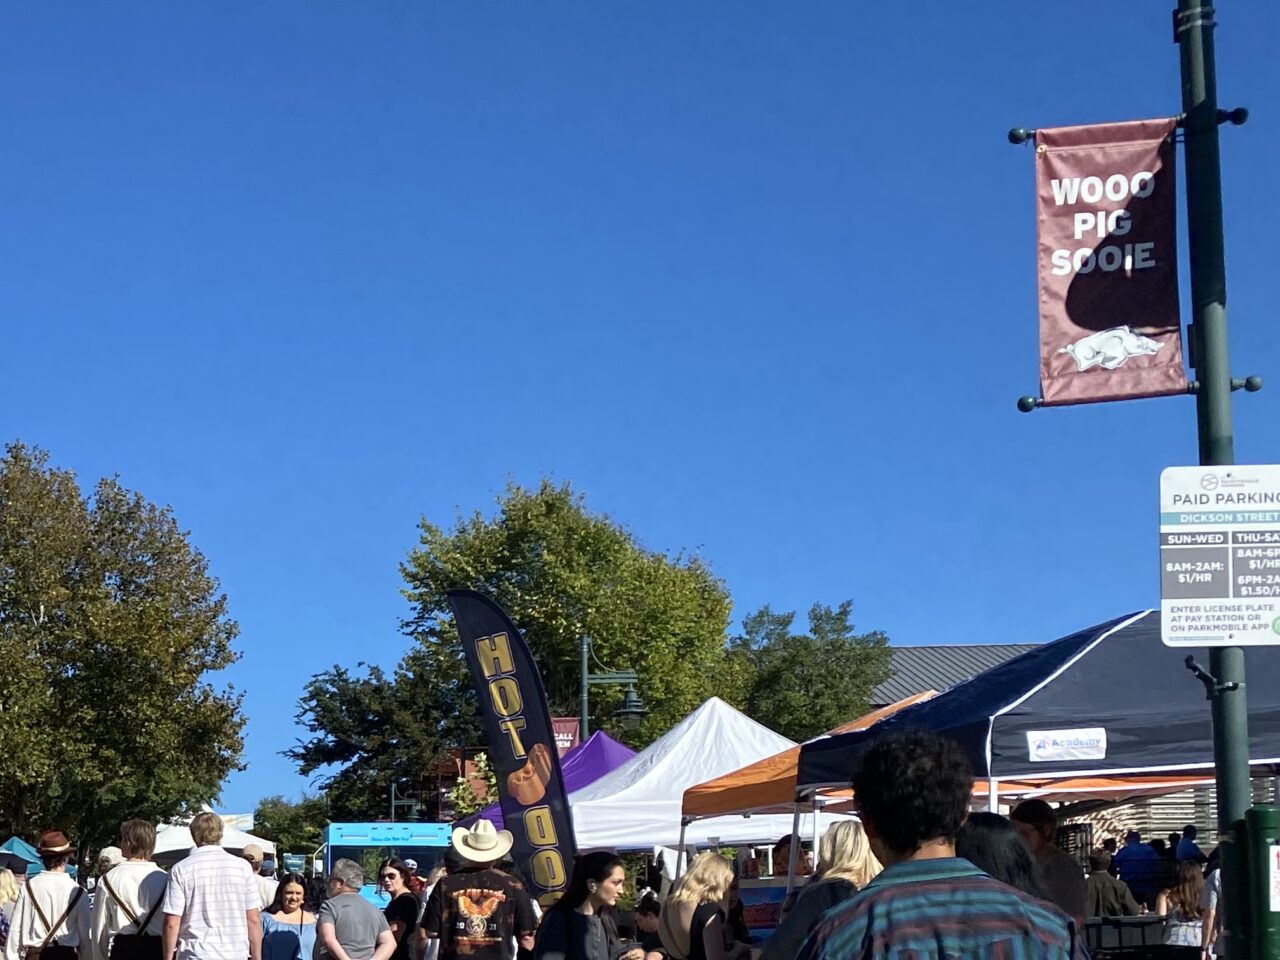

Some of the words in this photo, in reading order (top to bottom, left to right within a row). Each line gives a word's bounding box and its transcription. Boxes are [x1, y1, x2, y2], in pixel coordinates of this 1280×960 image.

[1051, 171, 1155, 205] WOOO
[1074, 209, 1132, 240] PIG
[1051, 242, 1156, 276] SOOIE
[1173, 493, 1210, 505] PAID
[1180, 513, 1233, 523] DICKSON
[1236, 512, 1279, 522] STREET
[1167, 534, 1224, 544] SUN-WED
[1236, 533, 1280, 542] THU-SA
[1166, 562, 1224, 572] 8AM-2AM:
[1178, 573, 1212, 584] $1/HR
[1170, 605, 1201, 614] ENTER
[1204, 604, 1243, 613] LICENSE
[1245, 604, 1275, 612] PLATE
[1170, 615, 1183, 623] AT
[1185, 615, 1202, 623] PAY
[1205, 614, 1244, 622] STATION
[1188, 623, 1248, 632] PARKMOBILE
[1250, 623, 1270, 631] APP
